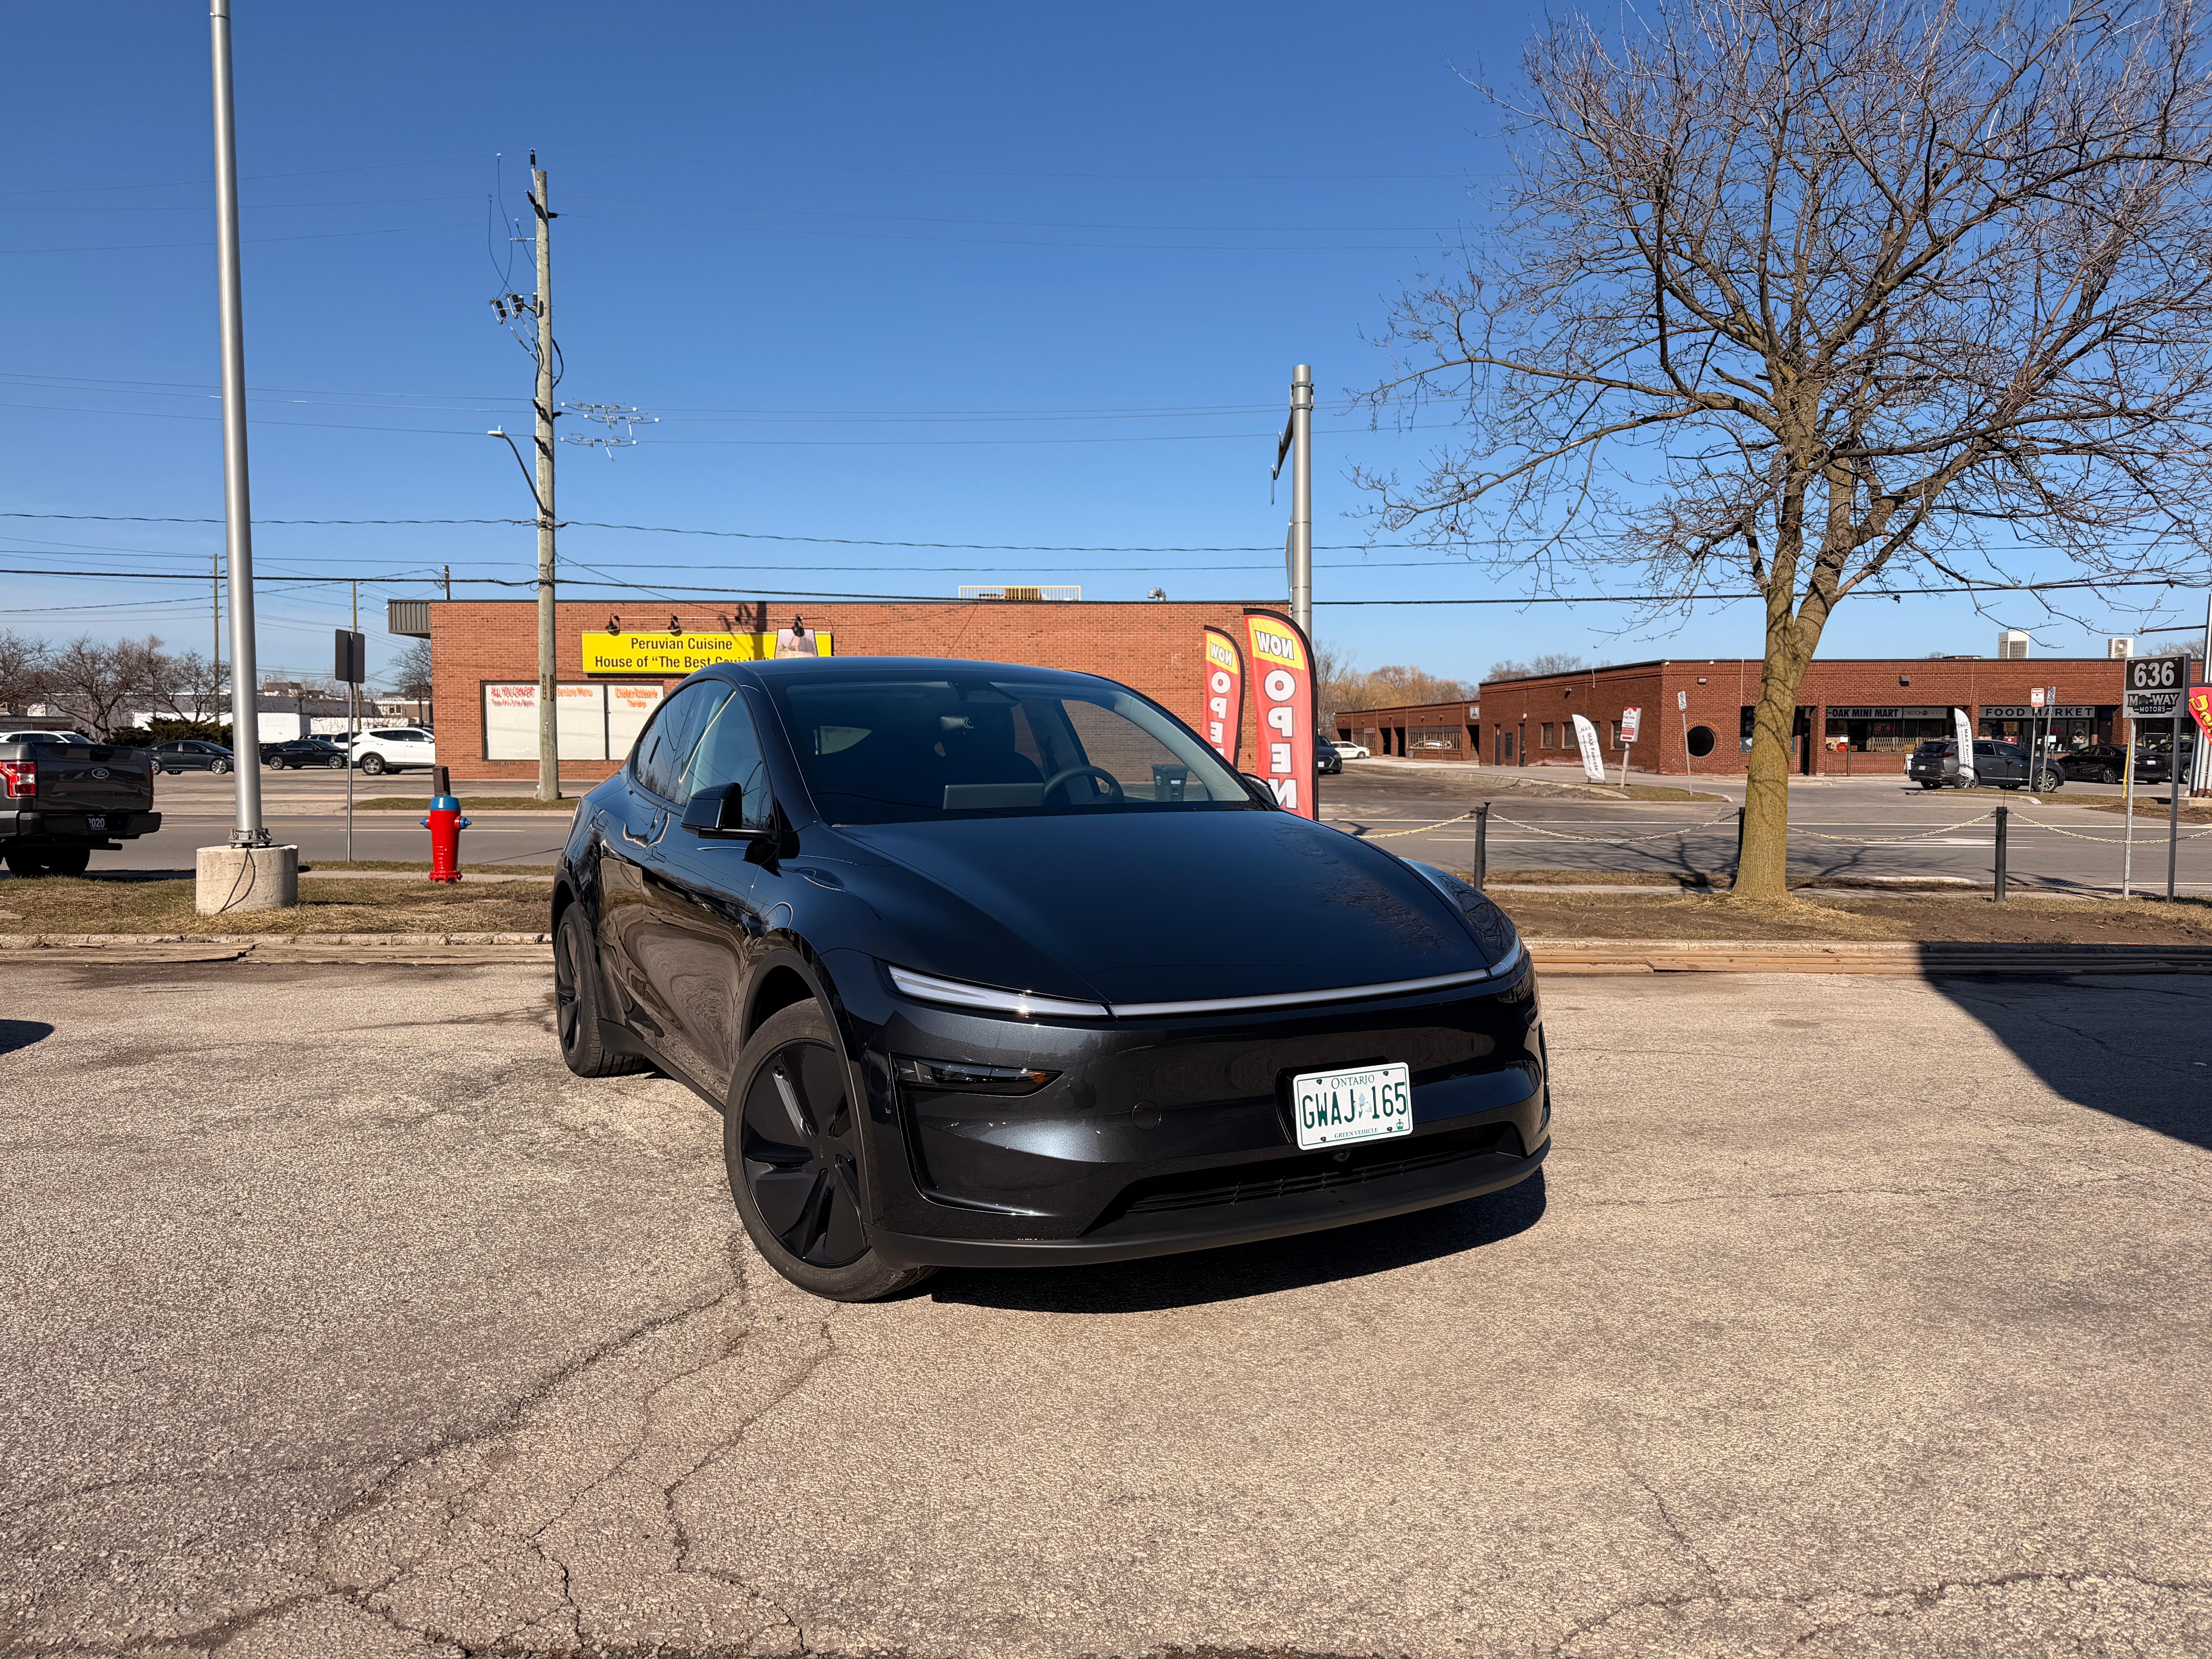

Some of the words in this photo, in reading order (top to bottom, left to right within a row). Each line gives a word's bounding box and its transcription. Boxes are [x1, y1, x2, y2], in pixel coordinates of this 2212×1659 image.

[631, 638, 684, 649] Peruvian
[688, 638, 733, 650] Cuisine
[595, 656, 632, 668] House
[637, 656, 649, 668] of
[685, 656, 711, 668] Best
[2134, 661, 2175, 687] 636
[576, 687, 592, 697] Menu
[1852, 709, 1873, 718] MINI
[1875, 709, 1899, 717] MART
[2032, 708, 2093, 716] MARKET
[1331, 1075, 1374, 1089] ONTARIO
[1302, 1089, 1355, 1129] GWAJ
[1372, 1082, 1407, 1119] 165
